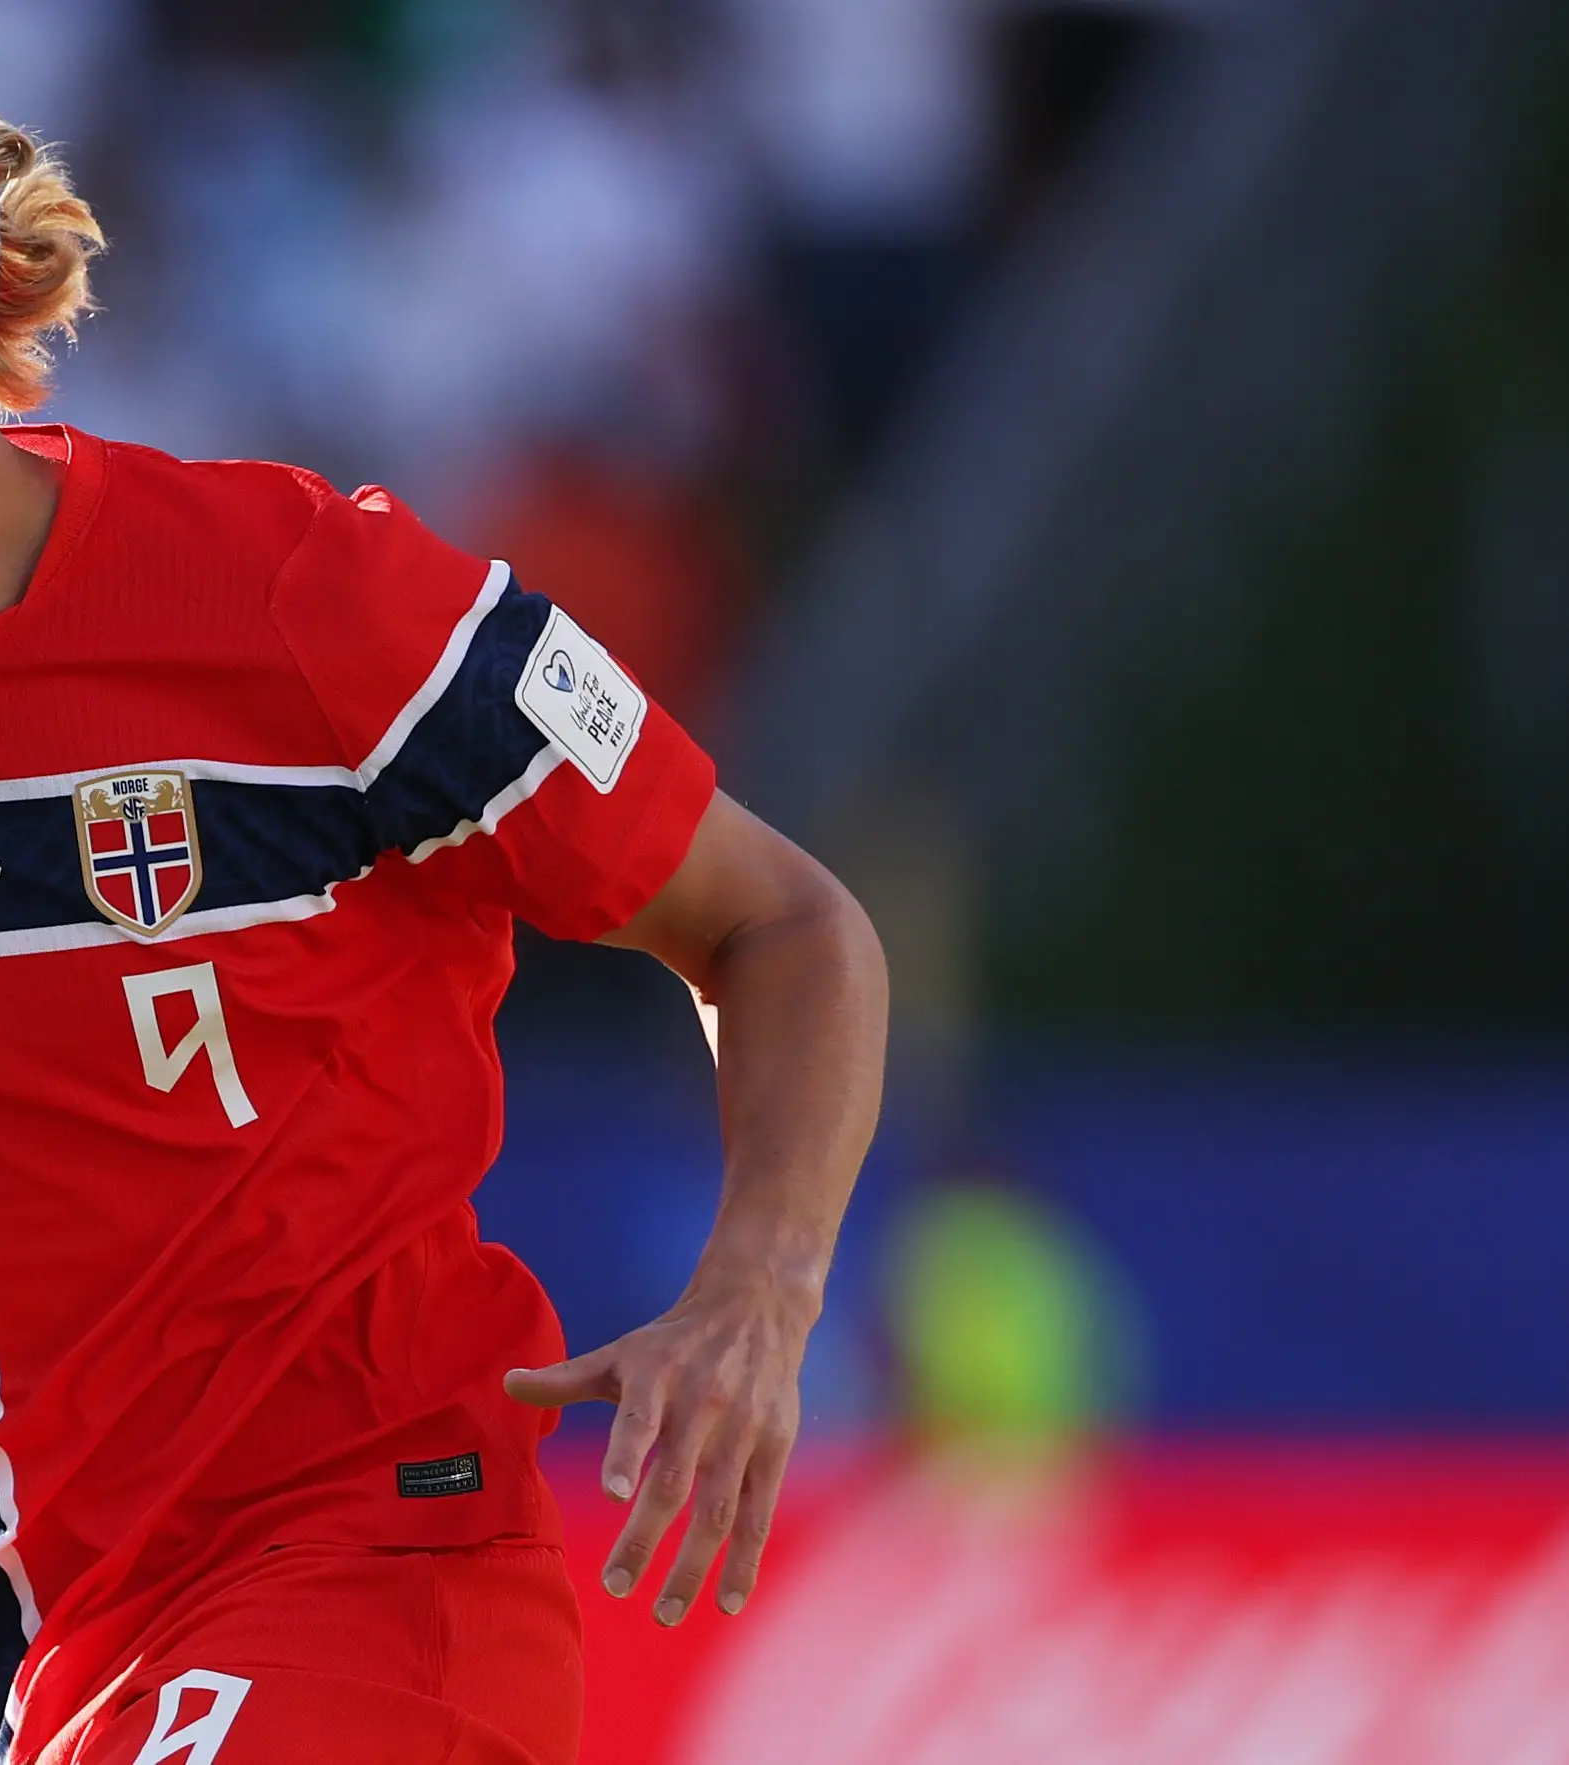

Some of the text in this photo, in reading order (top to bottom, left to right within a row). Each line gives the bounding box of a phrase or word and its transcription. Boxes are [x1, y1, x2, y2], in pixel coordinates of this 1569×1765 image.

[583, 672, 600, 699] For
[587, 690, 618, 745] PEACE
[609, 721, 626, 747] FIFA
[112, 777, 149, 796] NORGE
[121, 961, 259, 1129] 9
